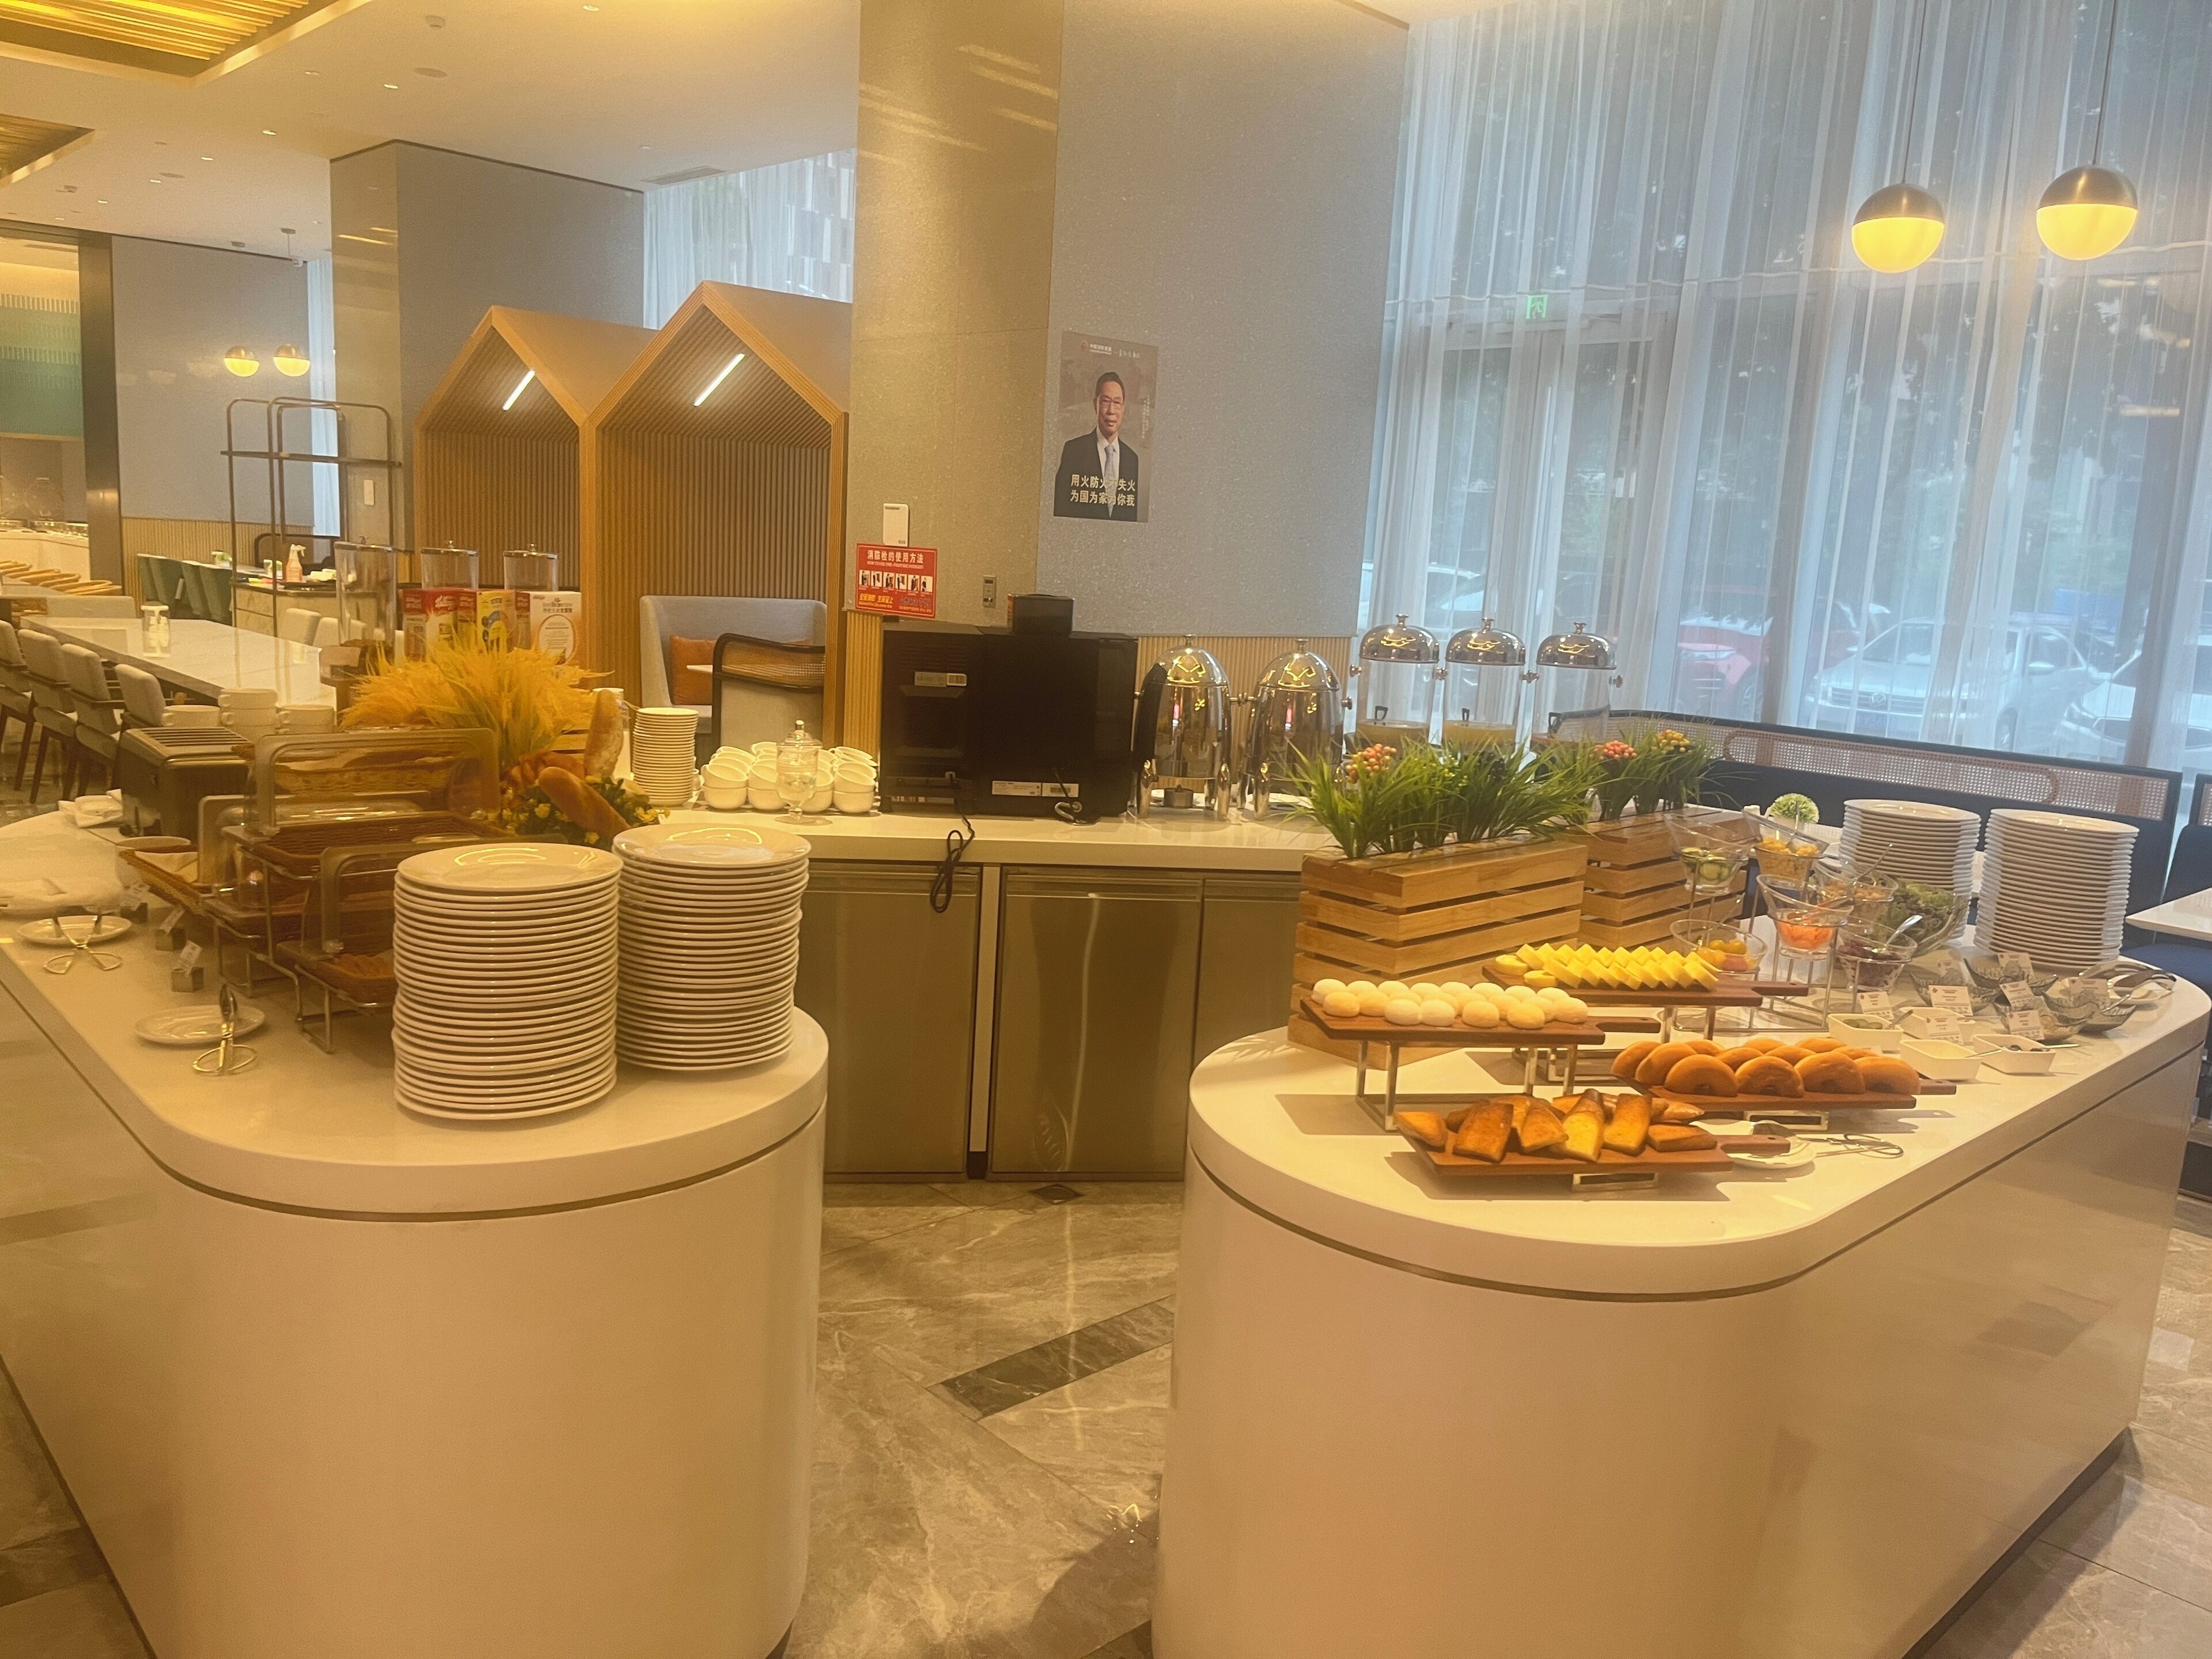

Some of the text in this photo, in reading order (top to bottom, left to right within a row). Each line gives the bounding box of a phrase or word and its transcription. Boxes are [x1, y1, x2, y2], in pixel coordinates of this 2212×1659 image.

[867, 550, 924, 564] 消防栓的使用方法
